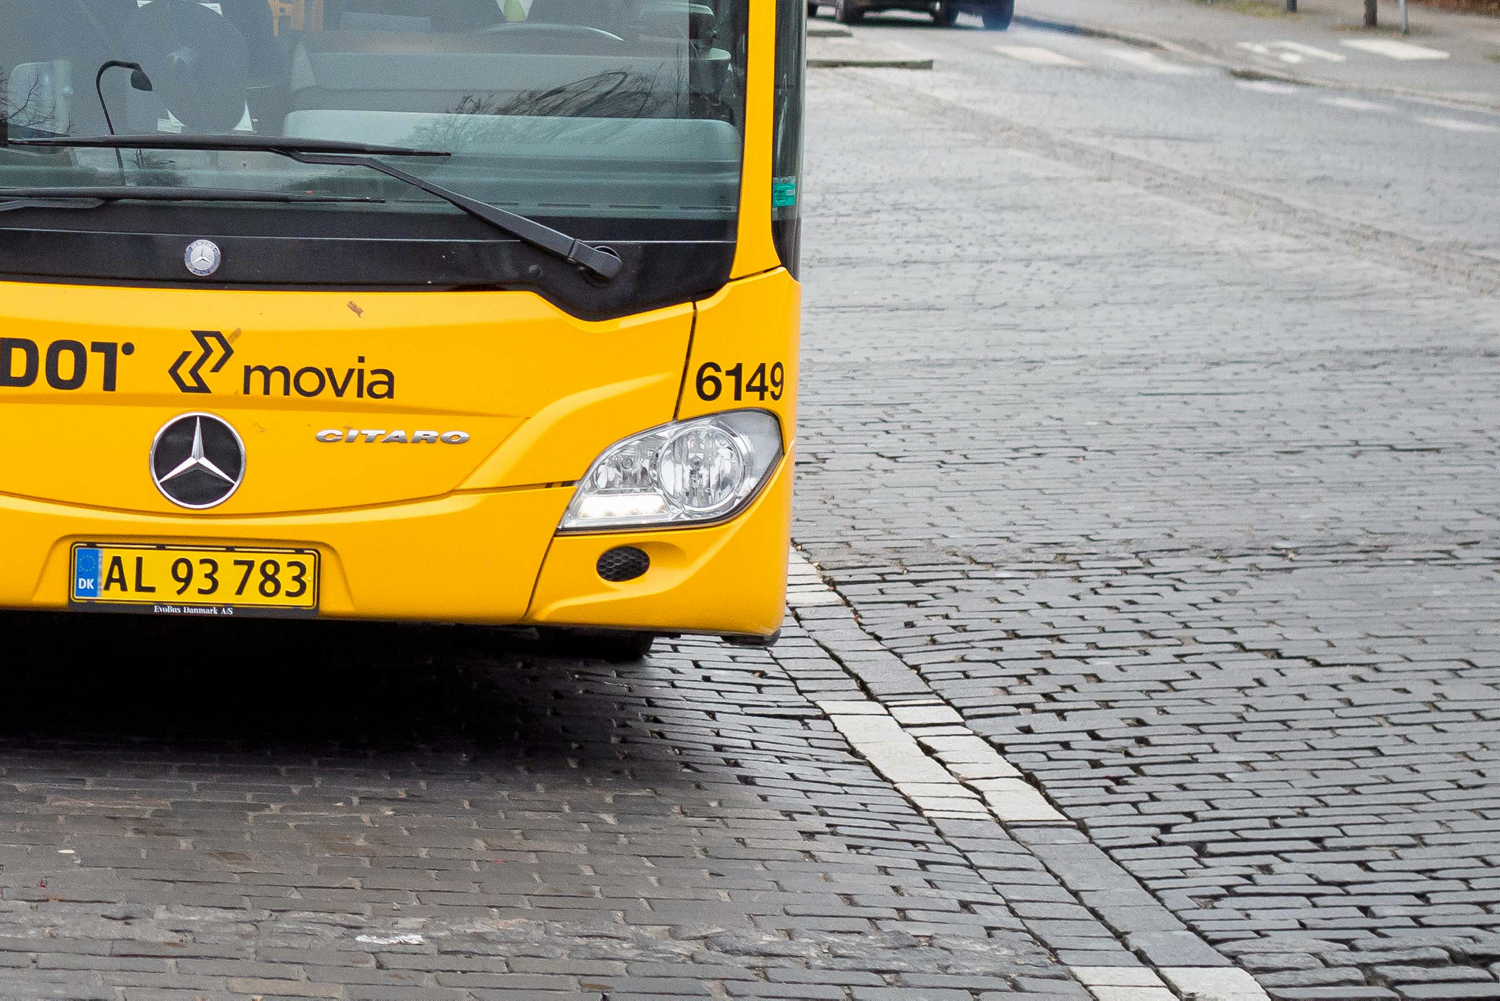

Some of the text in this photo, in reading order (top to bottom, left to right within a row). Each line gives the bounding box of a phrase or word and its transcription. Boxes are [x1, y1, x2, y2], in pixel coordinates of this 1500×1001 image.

[242, 355, 396, 400] movia
[695, 361, 785, 402] 6149
[315, 429, 471, 445] CITARO
[78, 577, 95, 590] DK
[102, 555, 308, 598] AL 93 783
[153, 604, 234, 616] EvoBus Danmark A/S
